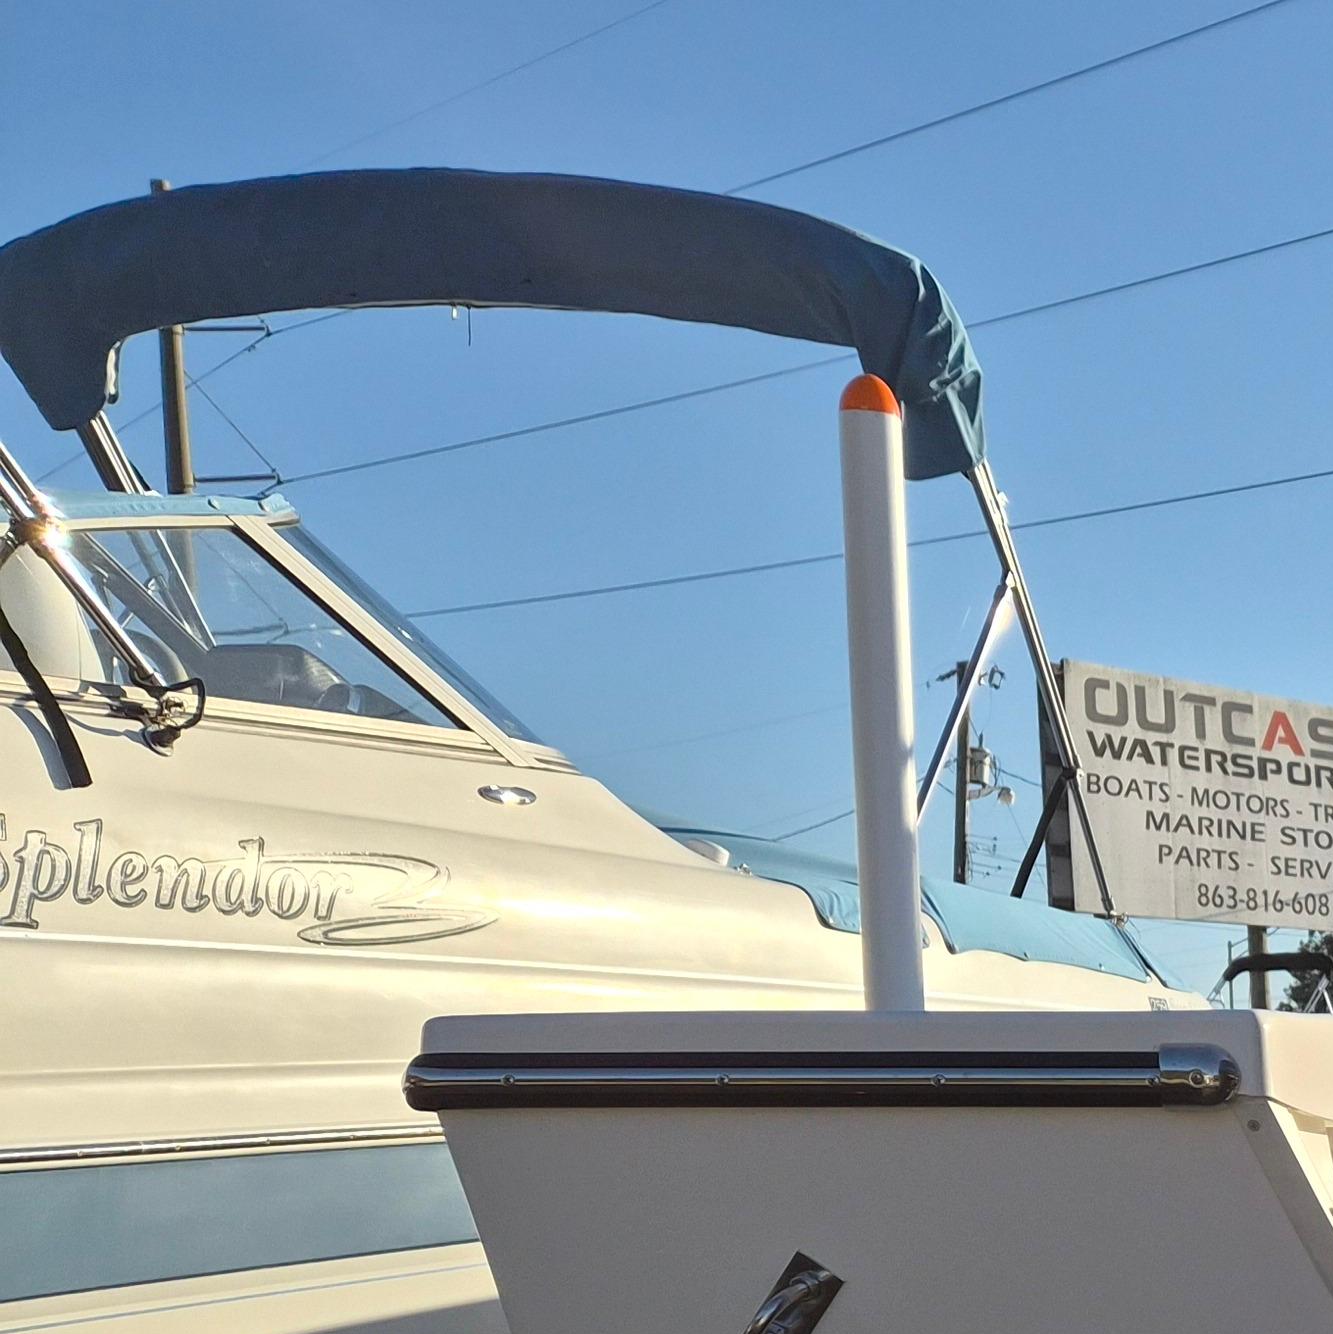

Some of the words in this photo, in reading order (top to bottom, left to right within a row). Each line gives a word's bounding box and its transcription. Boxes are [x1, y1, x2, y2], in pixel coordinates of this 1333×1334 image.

[1086, 772, 1171, 803] BOATS
[1190, 786, 1291, 819] MOTORS
[1145, 810, 1266, 843] MARINE
[1158, 843, 1240, 872] PARTS
